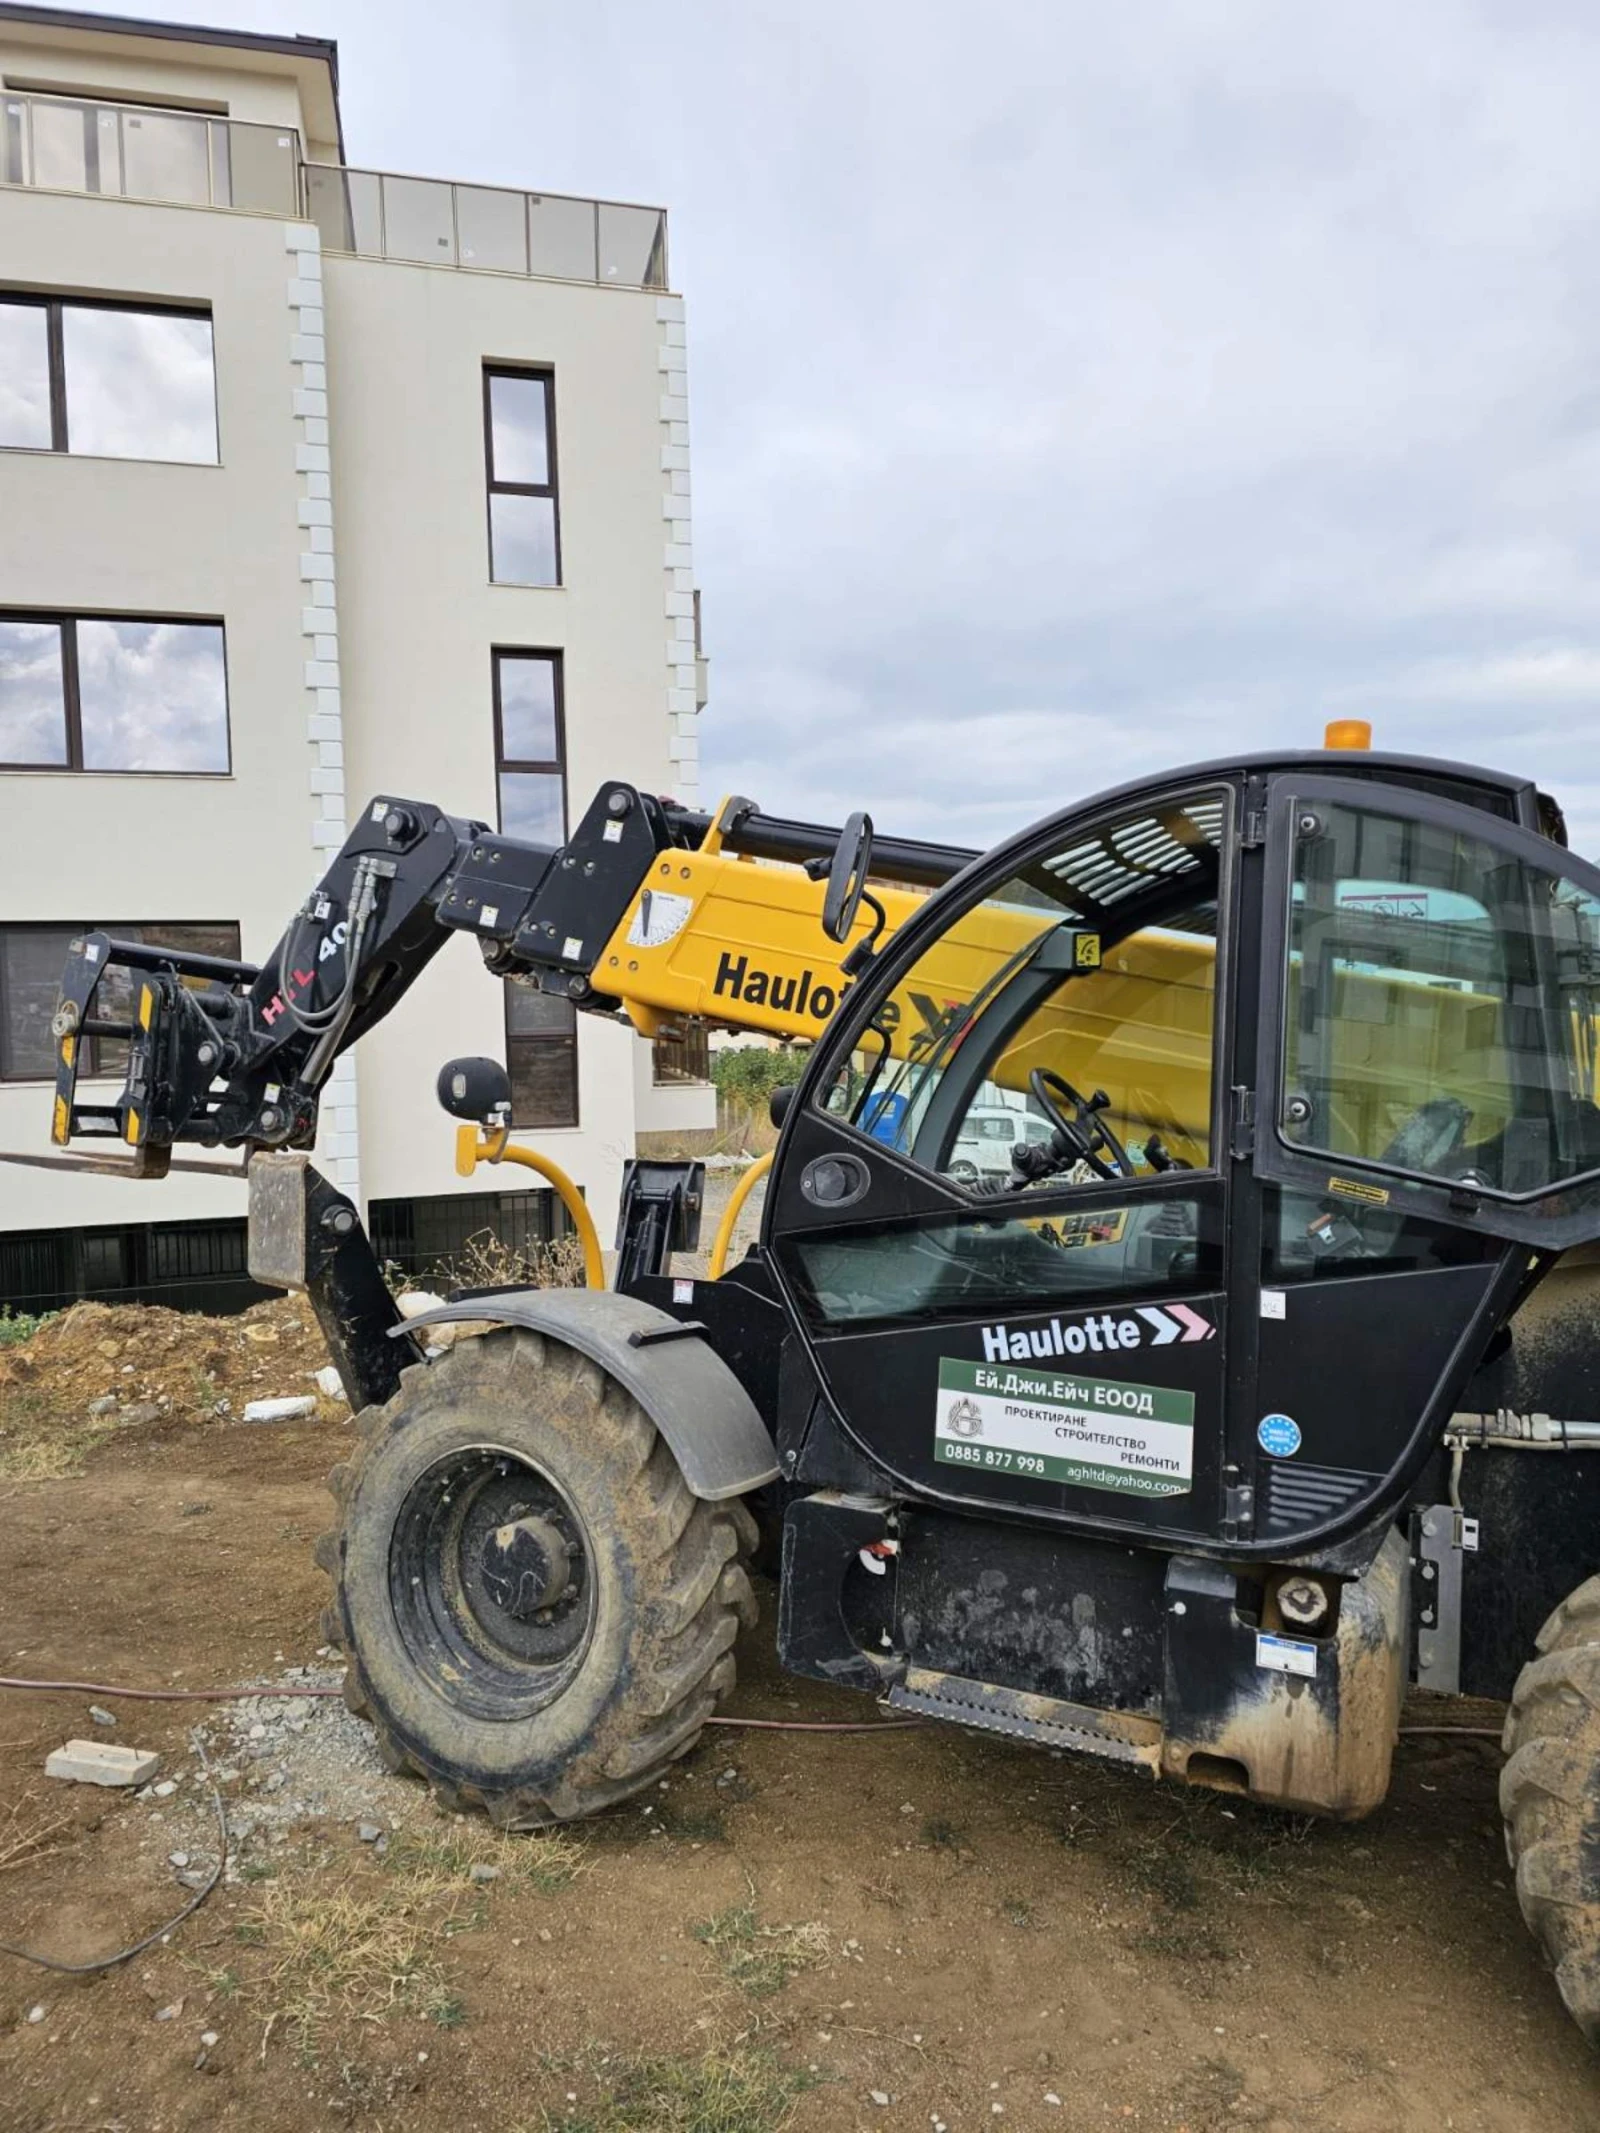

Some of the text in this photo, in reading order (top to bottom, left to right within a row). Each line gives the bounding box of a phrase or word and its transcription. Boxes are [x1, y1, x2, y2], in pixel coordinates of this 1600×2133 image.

[713, 952, 901, 1034] Hauloe
[982, 1315, 1141, 1362] Haulotte
[975, 1369, 1154, 1415] Ей.Джи.Ейч ЕООД
[1004, 1405, 1087, 1427] ПРОЕКТИРАНЕ
[1055, 1427, 1147, 1450] СТРОИТЕЛСТВО
[945, 1444, 1045, 1473] 0885 877 998
[1120, 1452, 1180, 1471] РЕМОНТИ
[1067, 1466, 1181, 1494] aghltd@yahoo.com
